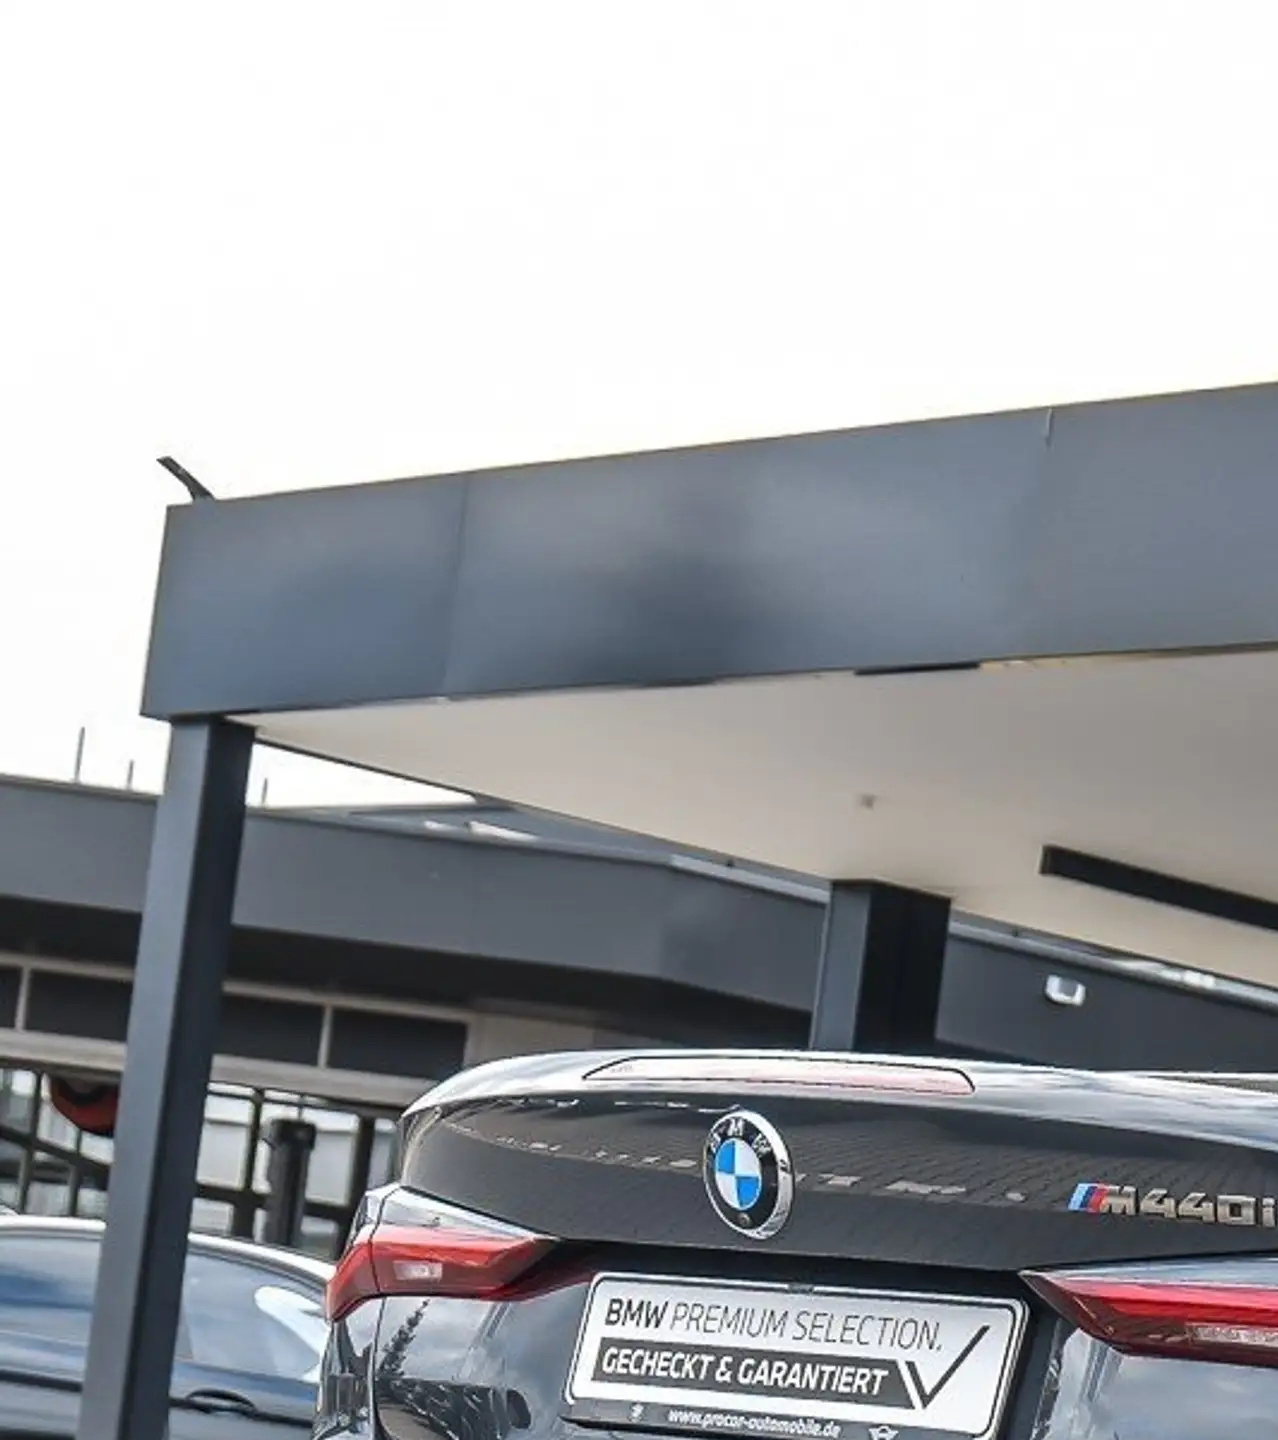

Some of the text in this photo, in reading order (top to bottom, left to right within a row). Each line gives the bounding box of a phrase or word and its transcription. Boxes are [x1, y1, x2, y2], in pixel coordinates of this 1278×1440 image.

[709, 1117, 773, 1159] BMW
[1068, 1182, 1276, 1227] M440i
[604, 1298, 943, 1351] BMW PREMIUM SELECTION.
[602, 1346, 889, 1396] GECHECKT & GARANTIERT
[667, 1408, 842, 1438] www.procar-automobile.de
